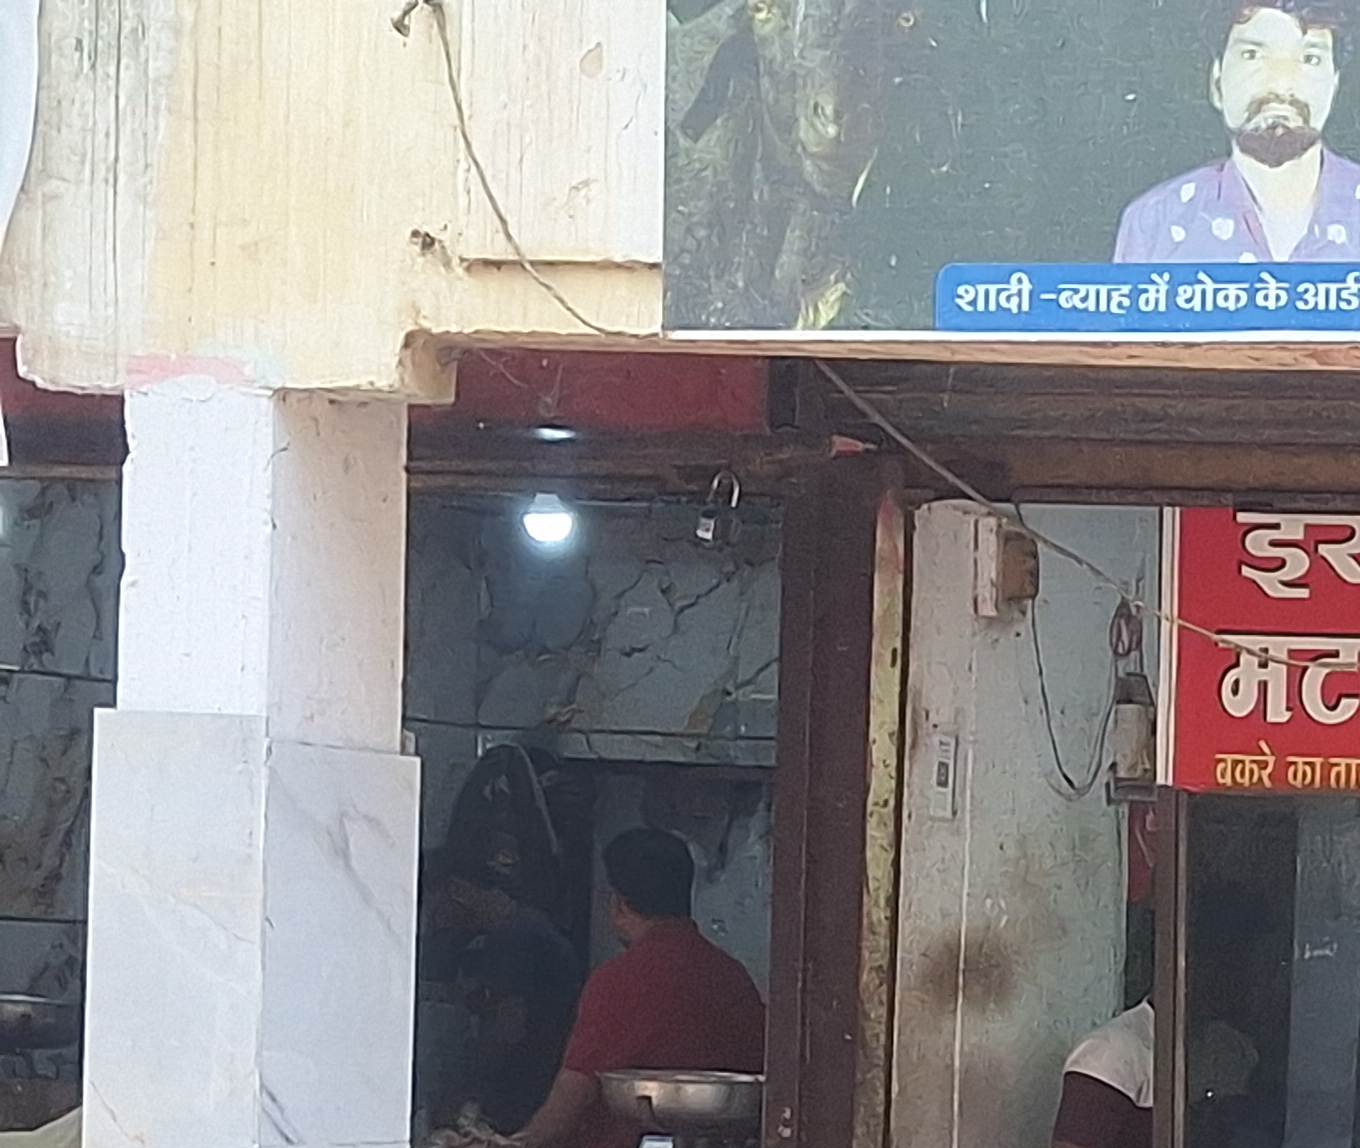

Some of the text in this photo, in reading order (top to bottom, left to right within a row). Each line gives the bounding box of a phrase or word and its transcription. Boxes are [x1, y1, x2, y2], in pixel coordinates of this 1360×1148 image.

[955, 272, 1032, 313] शादी
[1138, 272, 1169, 311] में
[1176, 272, 1248, 311] थोक
[1255, 272, 1289, 311] के
[1286, 756, 1325, 788] का
